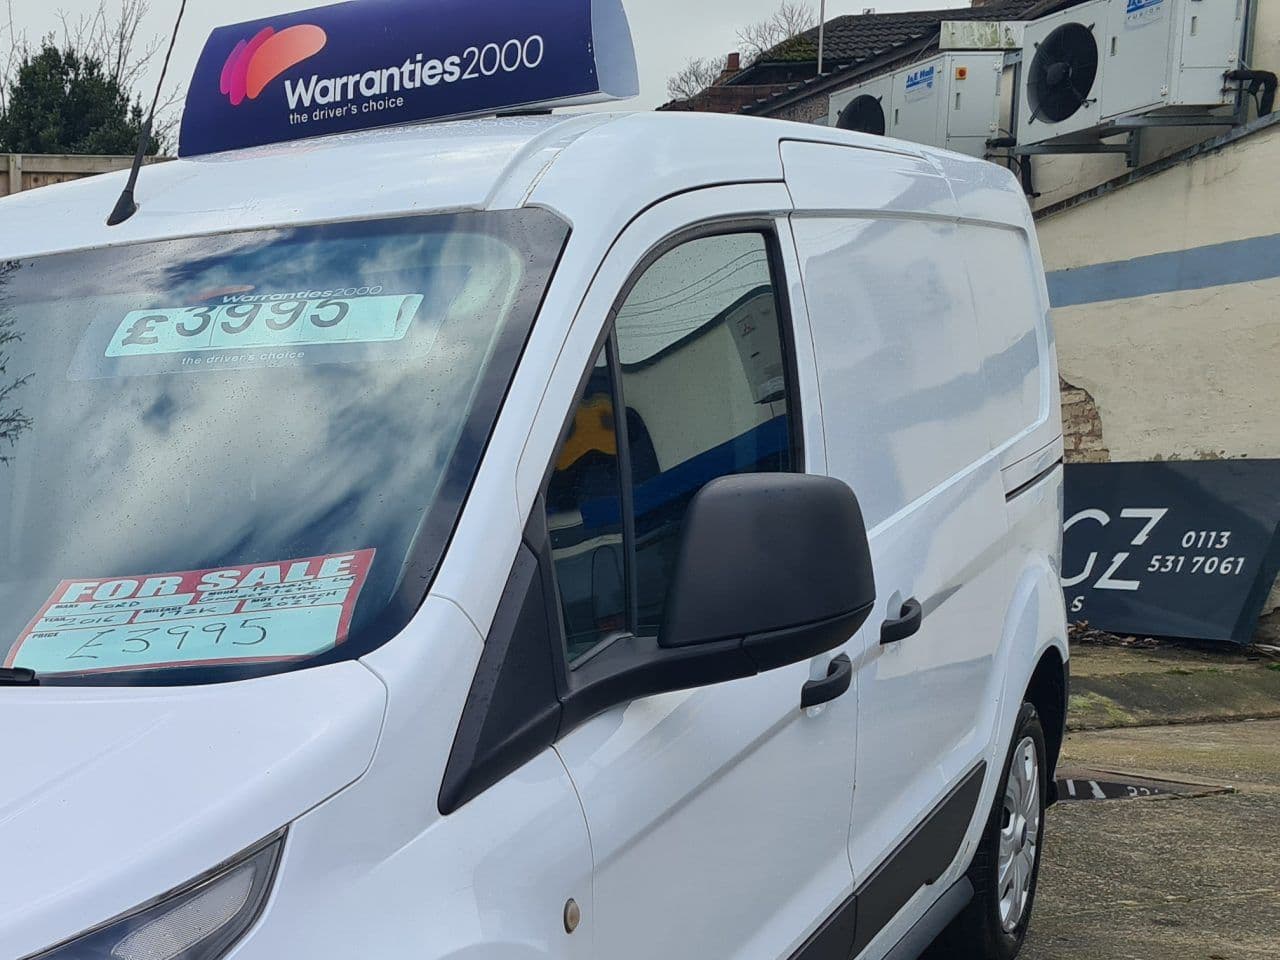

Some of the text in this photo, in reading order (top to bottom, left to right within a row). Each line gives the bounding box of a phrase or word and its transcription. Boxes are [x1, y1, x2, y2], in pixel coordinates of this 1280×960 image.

[284, 34, 544, 109] Warranties2000
[289, 96, 404, 124] the driver's choice
[121, 299, 349, 346] £3995
[182, 357, 202, 365] the
[1181, 531, 1231, 549] 0113
[62, 554, 356, 603] FOR SALE
[1147, 555, 1245, 575] 531 7061
[90, 600, 141, 610] FORD
[66, 616, 272, 661] £3995
